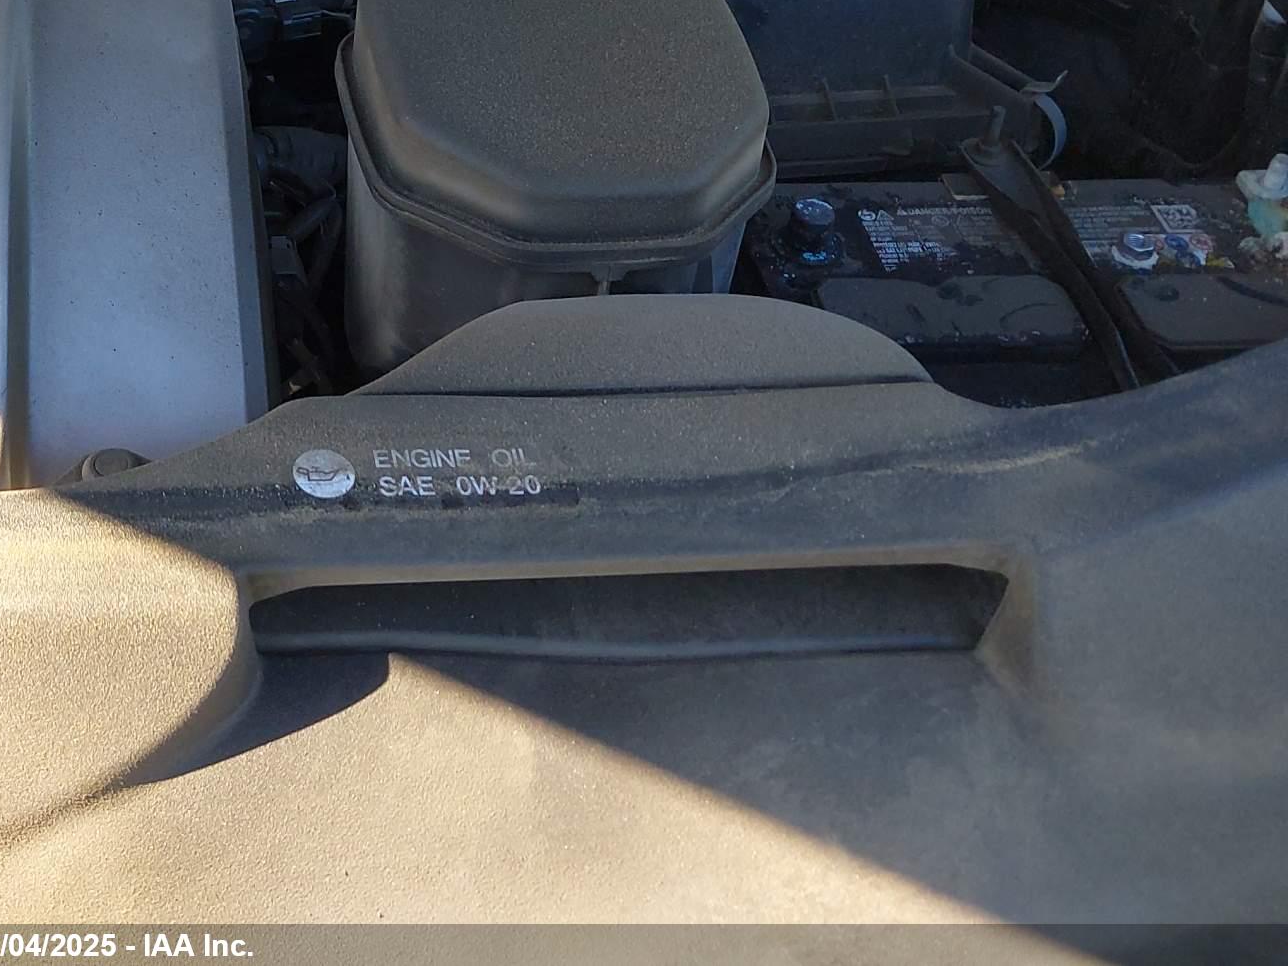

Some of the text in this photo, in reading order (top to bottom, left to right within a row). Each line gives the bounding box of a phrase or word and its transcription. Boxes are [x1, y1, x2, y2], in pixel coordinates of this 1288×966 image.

[372, 447, 537, 469] ENGINE OIL
[378, 474, 437, 497] SAE
